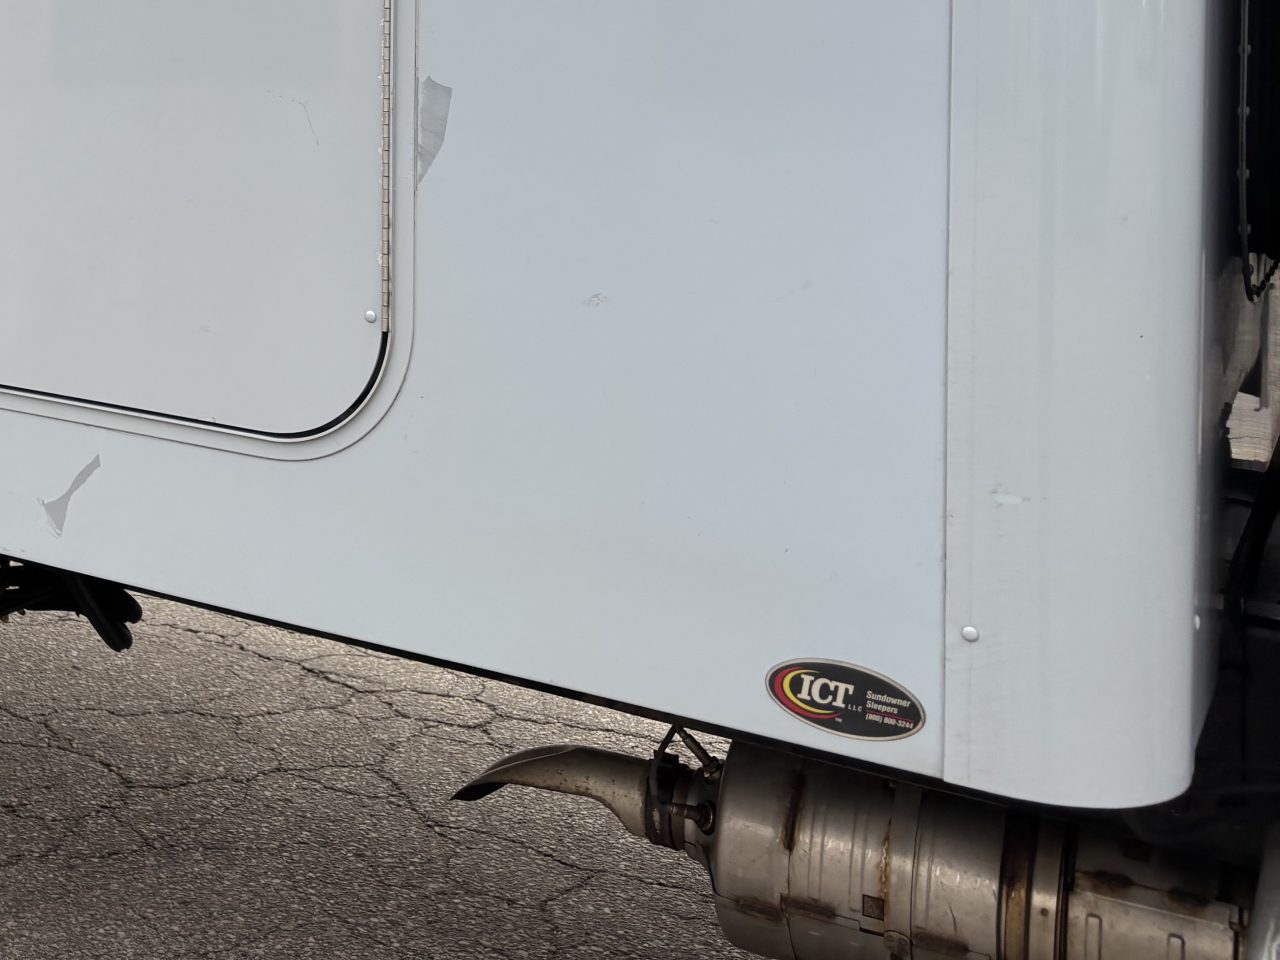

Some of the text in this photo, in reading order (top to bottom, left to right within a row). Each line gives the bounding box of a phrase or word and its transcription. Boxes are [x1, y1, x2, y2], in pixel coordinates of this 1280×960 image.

[797, 674, 854, 708] ICT
[866, 691, 911, 708] Sundowner
[866, 701, 898, 715] Sleepers
